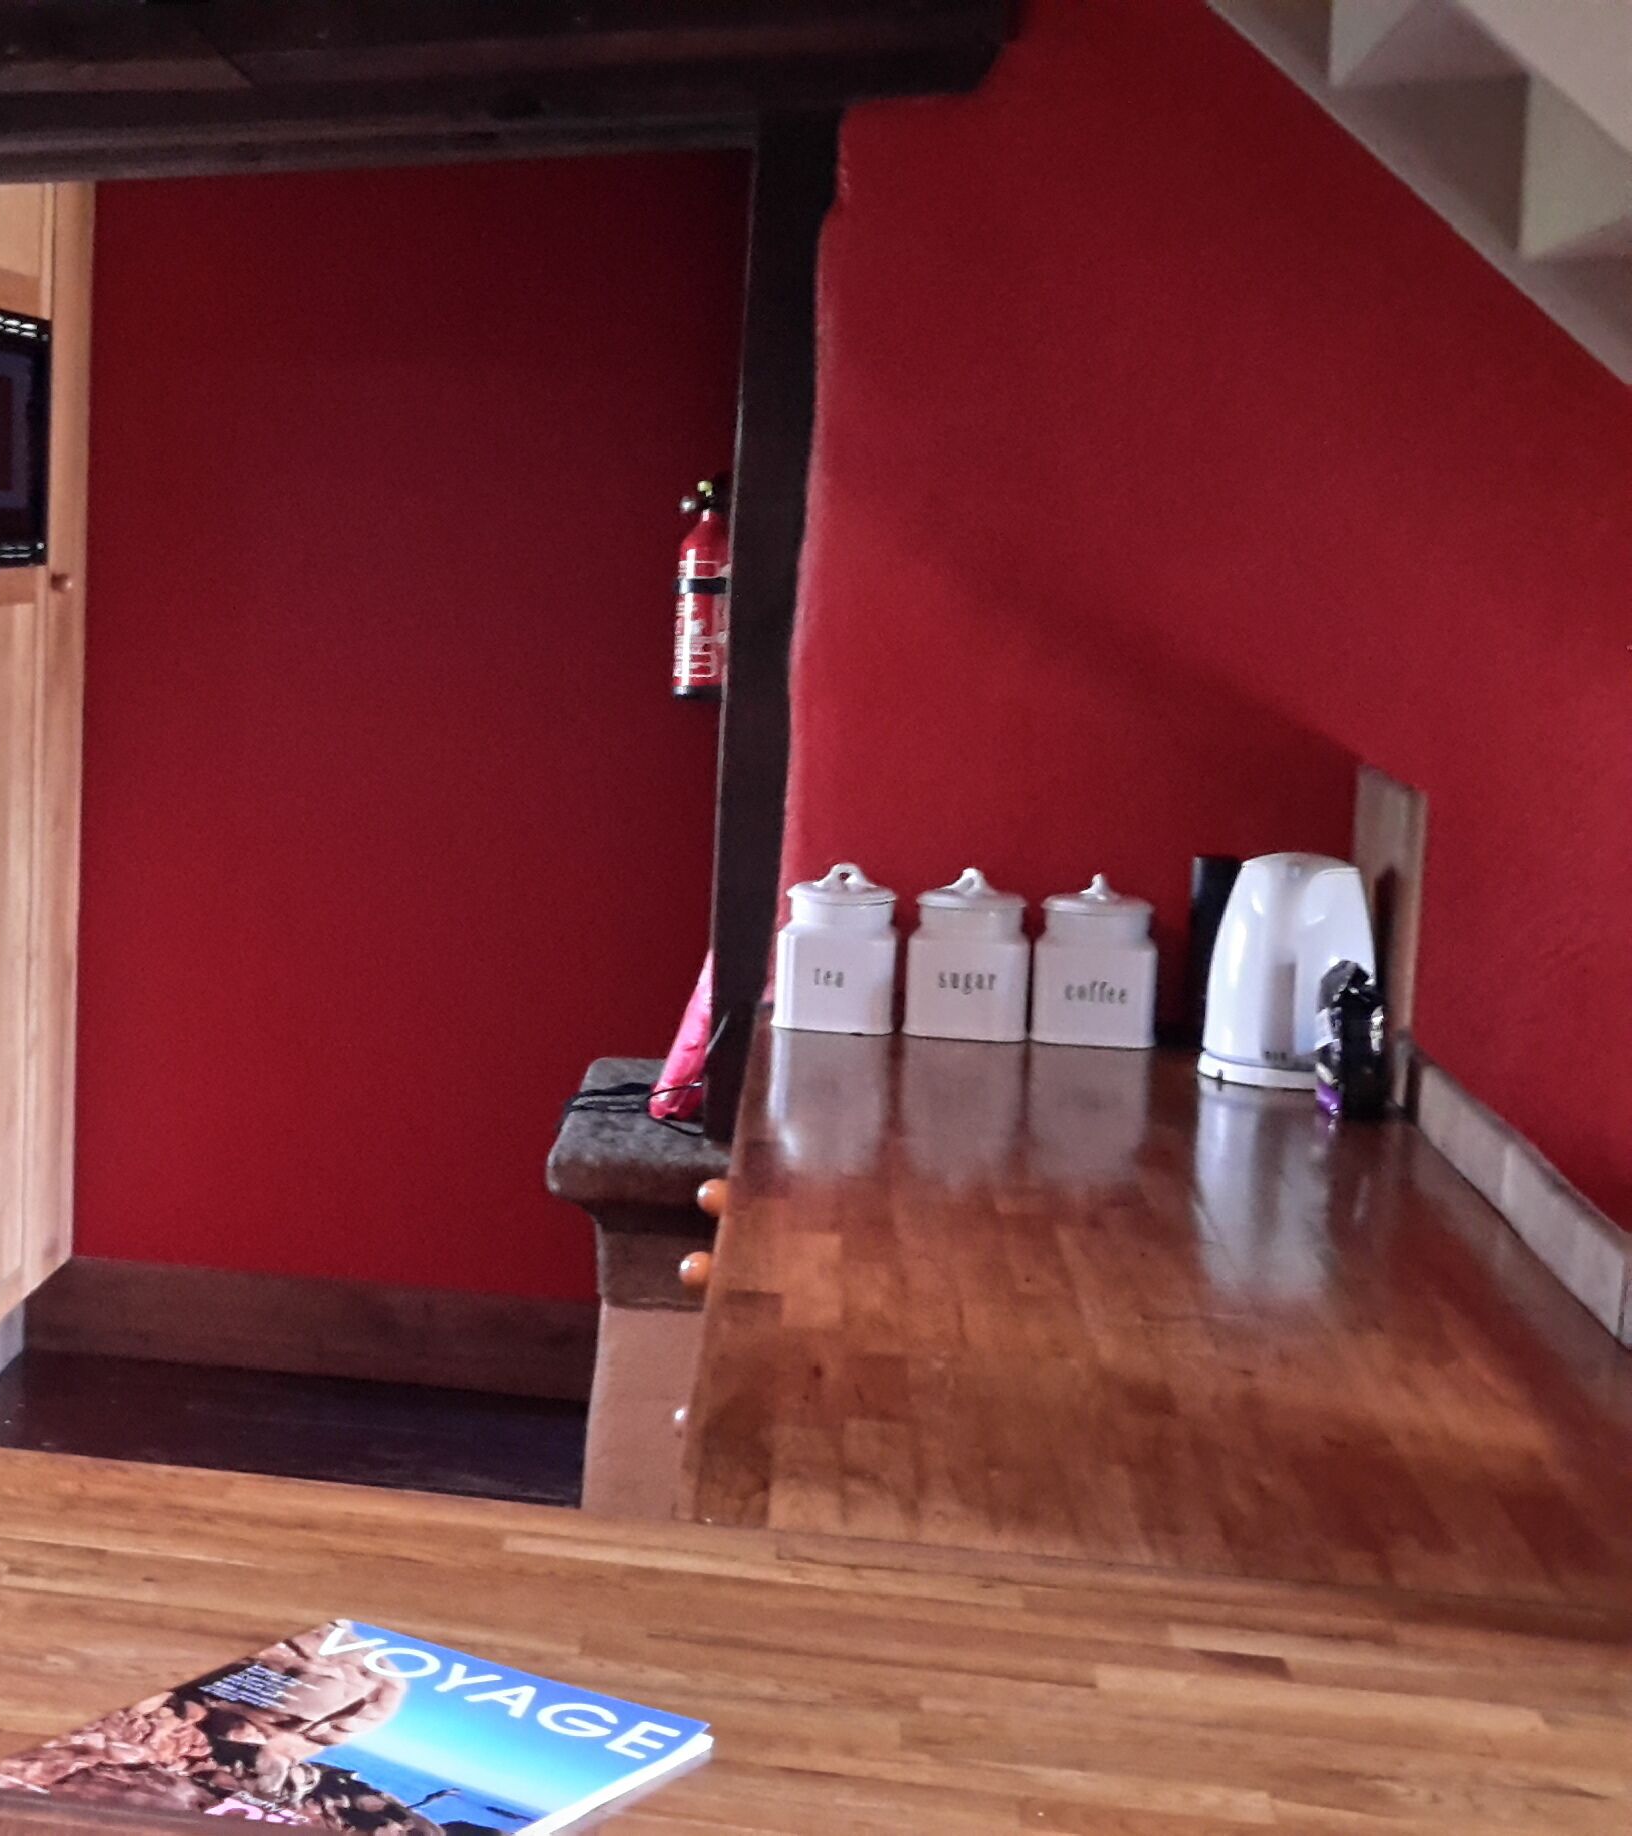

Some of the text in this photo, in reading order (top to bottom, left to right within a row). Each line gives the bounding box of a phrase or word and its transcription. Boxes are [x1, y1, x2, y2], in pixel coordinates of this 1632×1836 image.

[813, 967, 845, 989] tea
[937, 970, 997, 996] sugar
[1064, 980, 1128, 1005] coffee
[317, 1627, 682, 1760] VOYAGE
